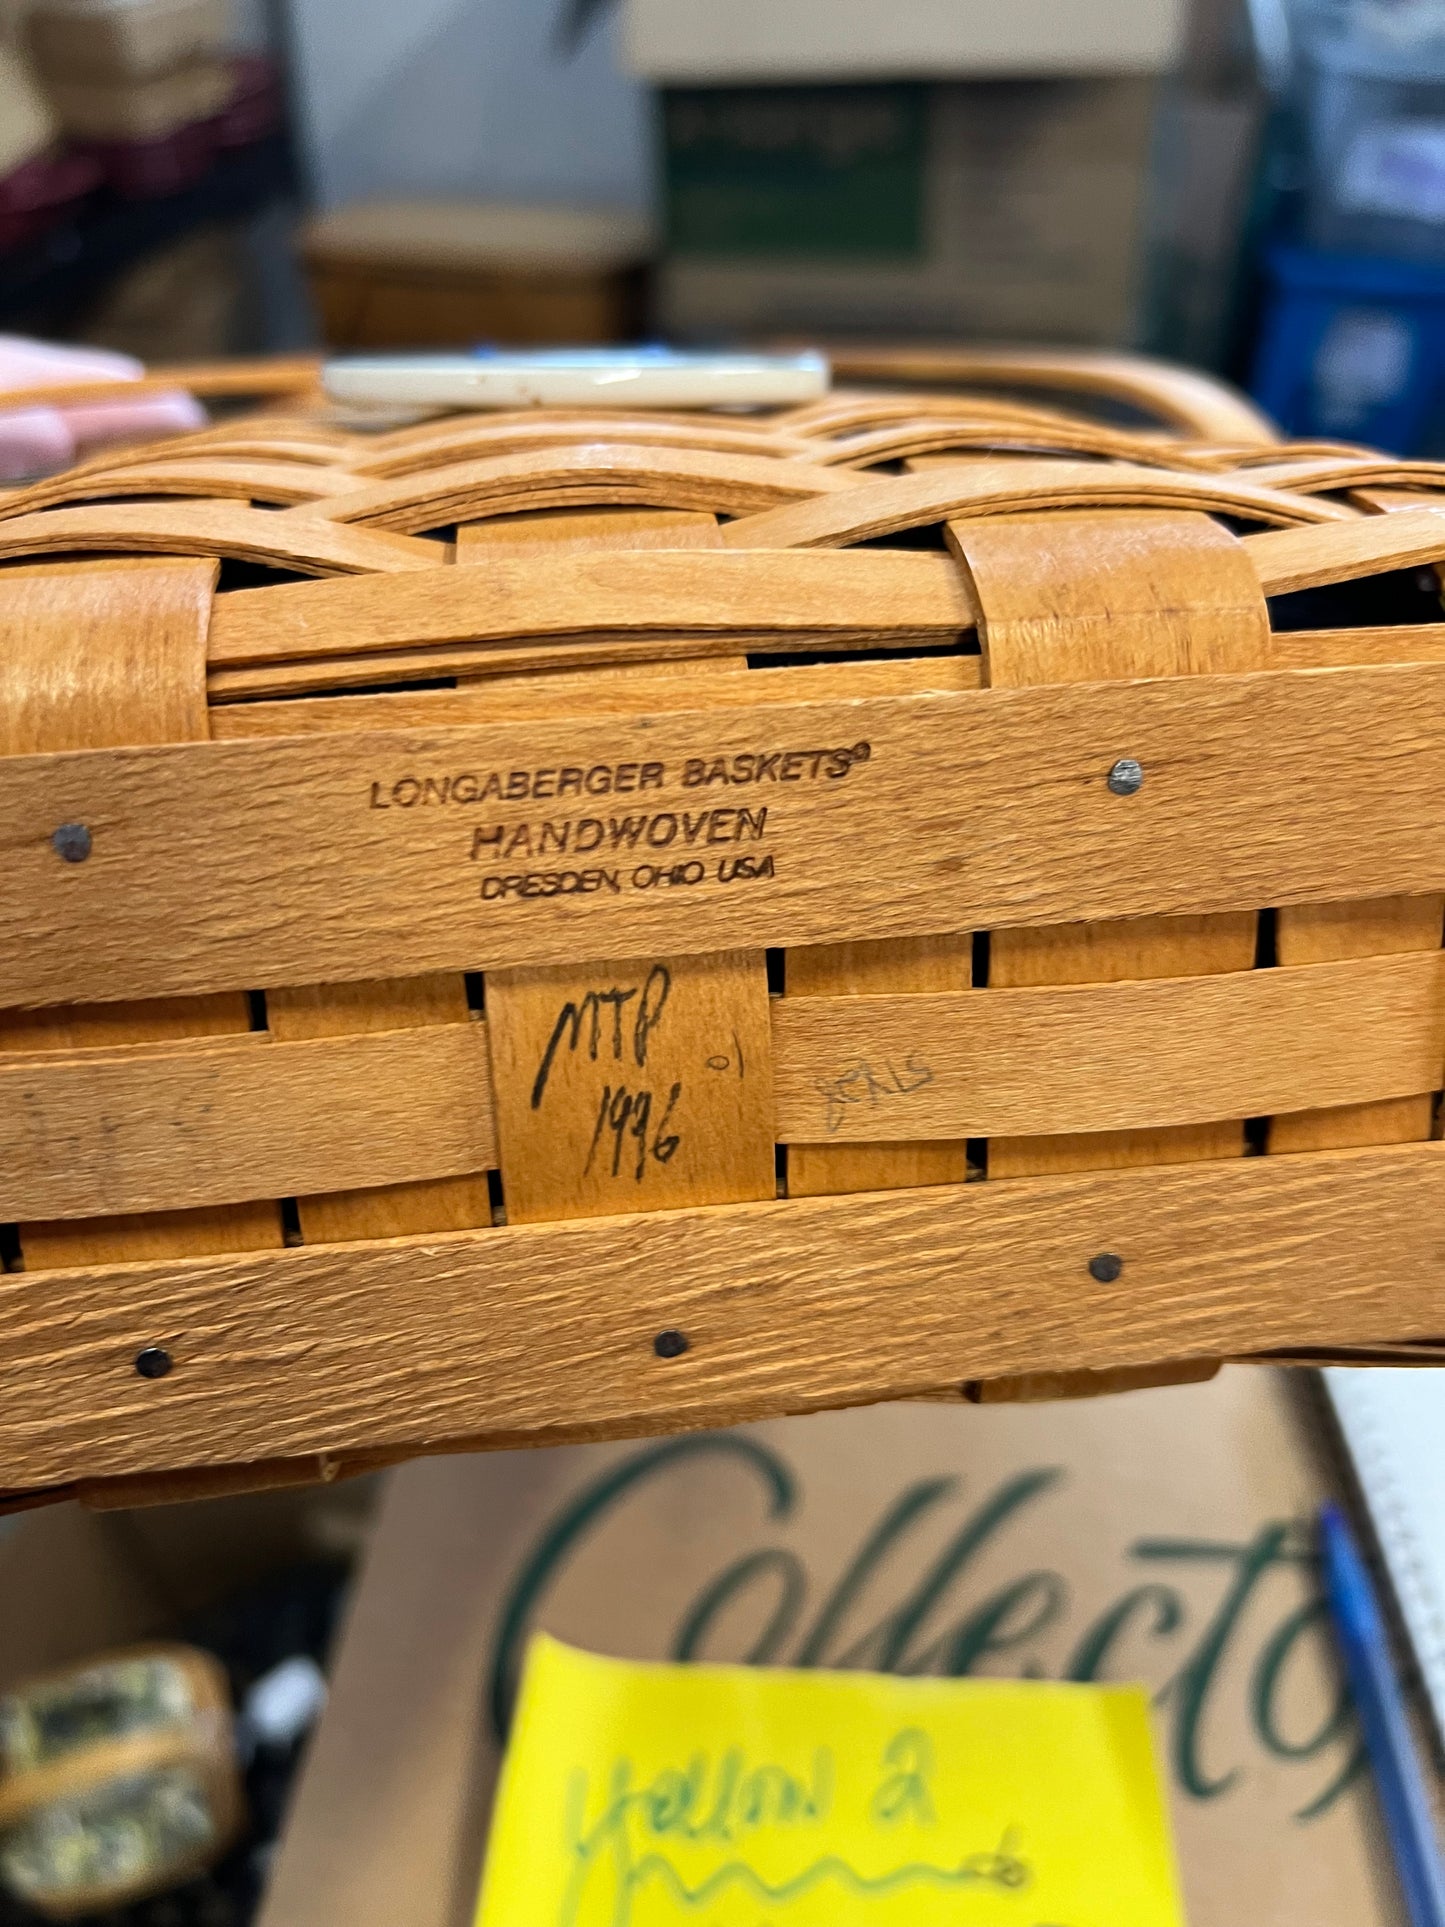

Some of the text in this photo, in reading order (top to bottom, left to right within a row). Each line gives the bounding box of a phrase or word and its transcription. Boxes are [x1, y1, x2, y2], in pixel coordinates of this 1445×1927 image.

[369, 760, 664, 809] LONGABERGER
[469, 806, 768, 861] HANDWOVEN
[631, 860, 705, 889] OHIO
[717, 855, 775, 883] USA
[583, 1079, 682, 1184] 1996
